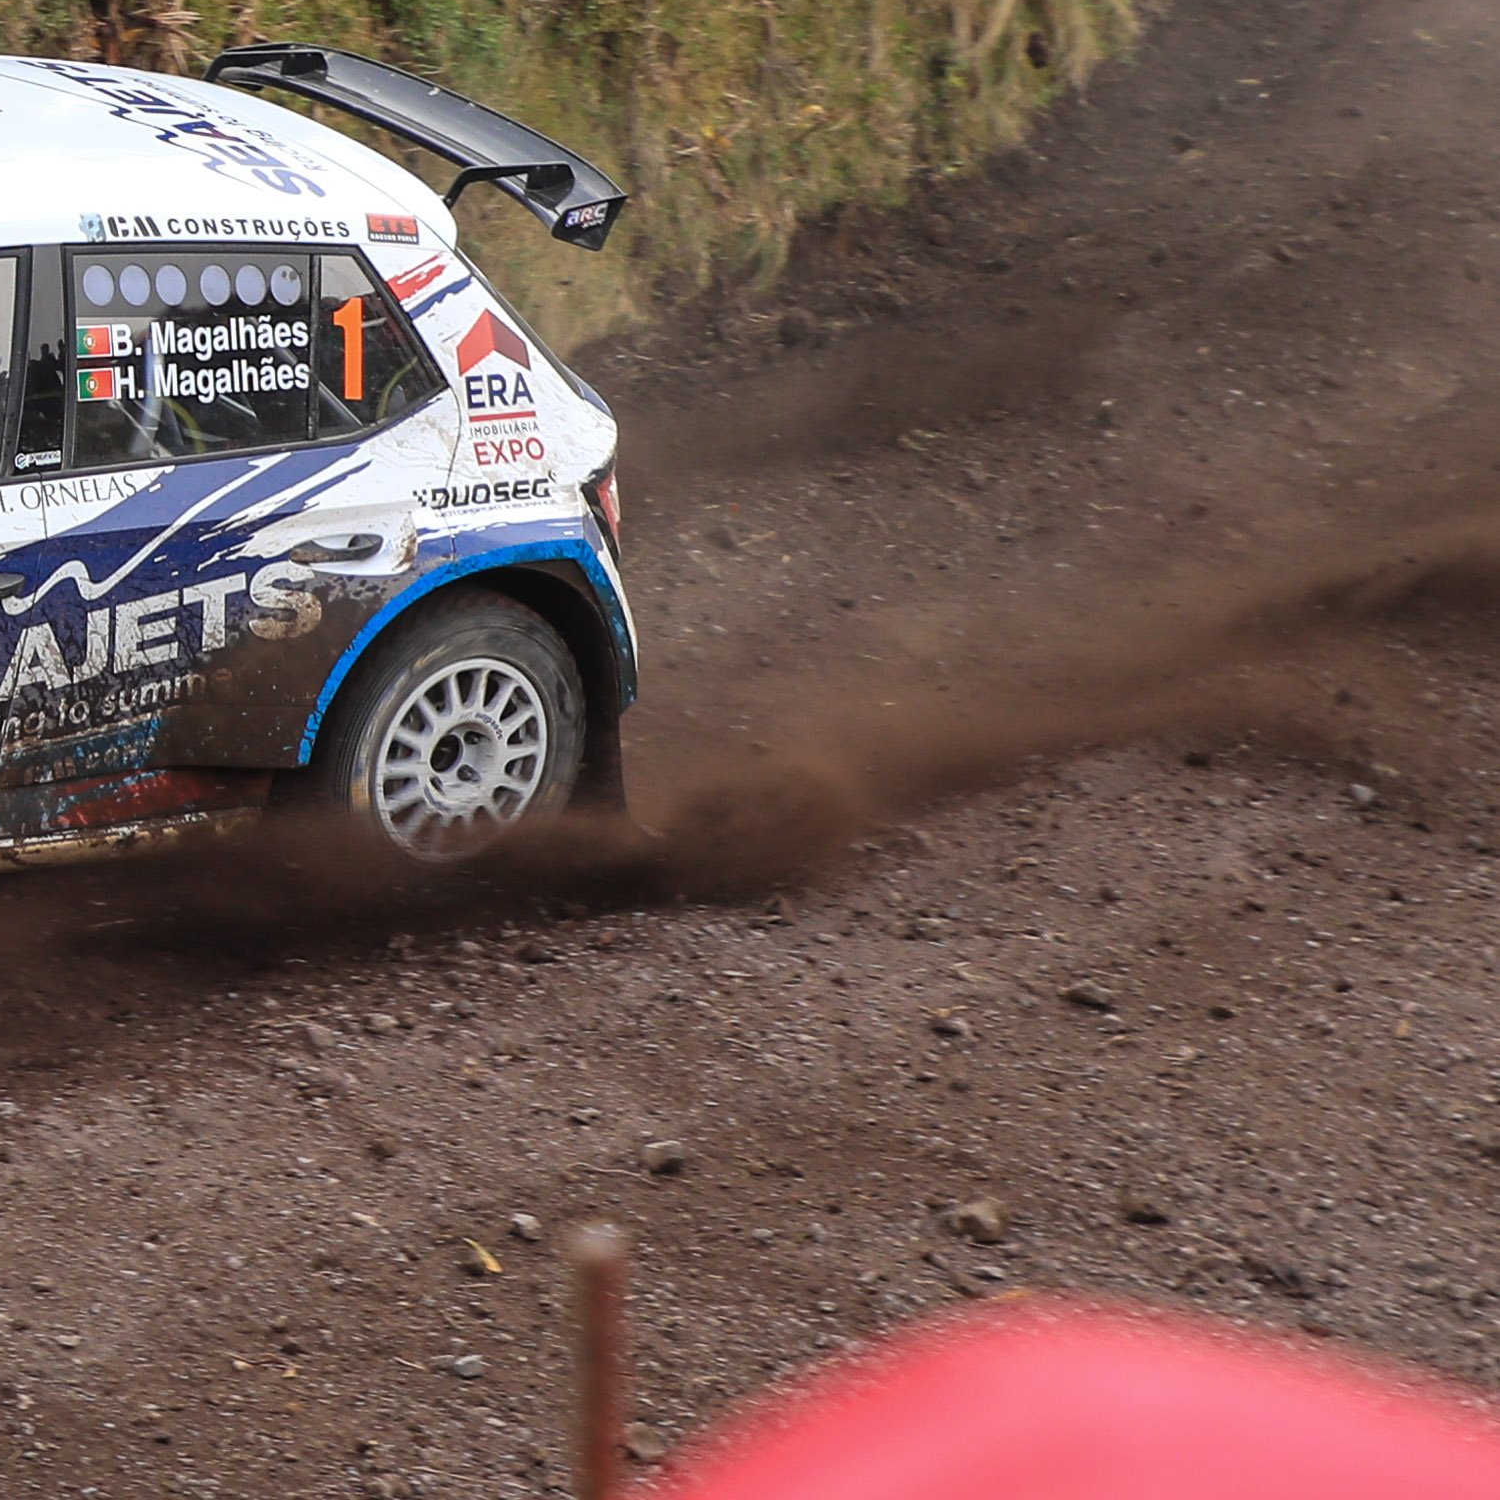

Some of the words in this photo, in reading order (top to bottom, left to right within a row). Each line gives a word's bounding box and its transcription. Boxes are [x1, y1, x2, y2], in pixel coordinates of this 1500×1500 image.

[17, 60, 326, 198] SEAJETS
[167, 217, 350, 240] CONSTRUÇÕES
[369, 214, 416, 234] ETS
[112, 324, 142, 357] B.
[151, 315, 309, 361] Magalhães
[333, 297, 363, 400] 1
[114, 366, 145, 400] H.
[153, 357, 310, 403] Magalhães
[465, 372, 534, 409] ERA
[474, 437, 545, 466] EXPO
[20, 473, 138, 510] ORNELAS
[431, 479, 550, 509] DUOSEG
[58, 698, 90, 728] to
